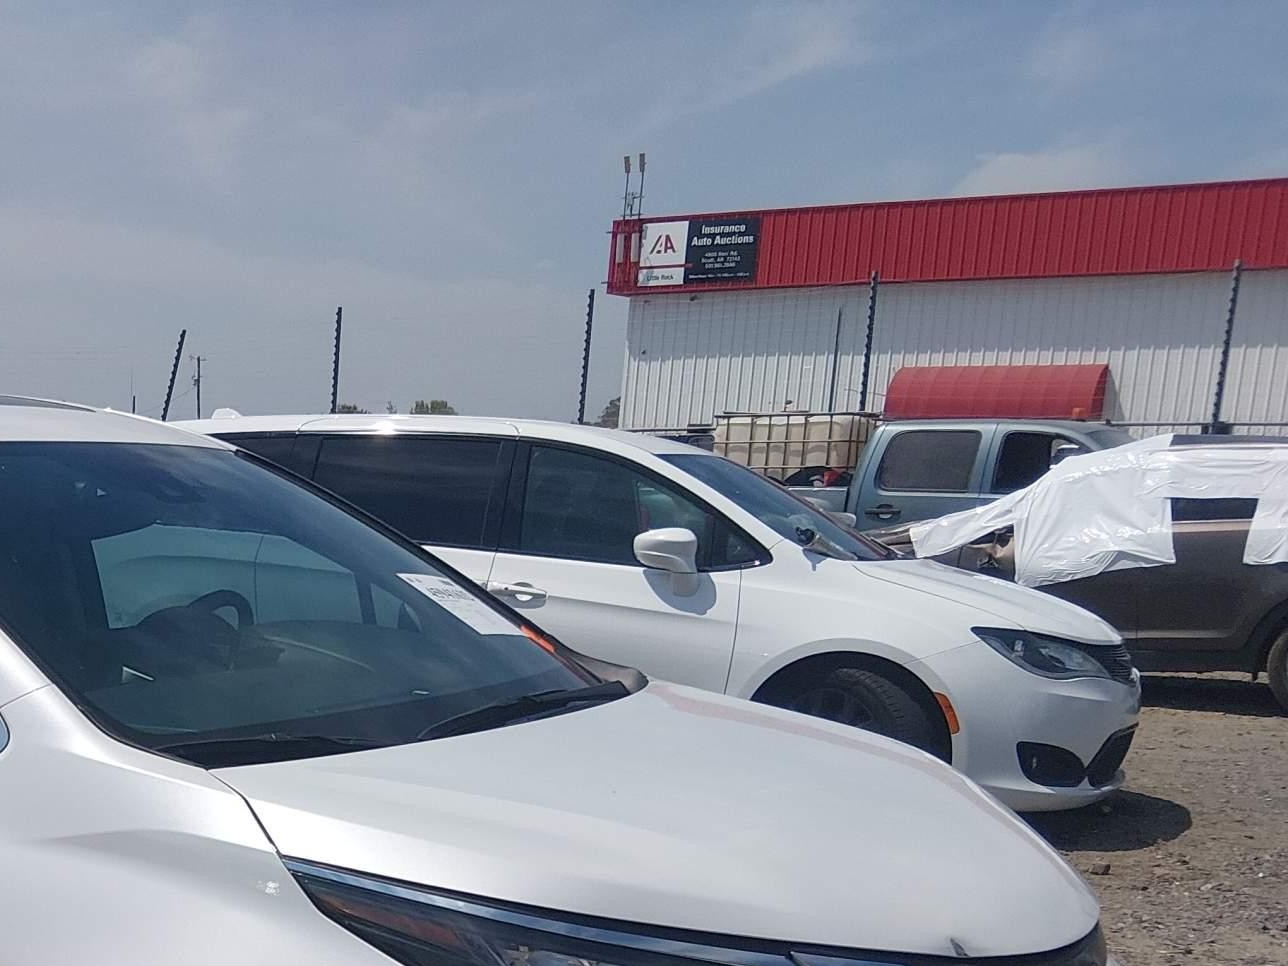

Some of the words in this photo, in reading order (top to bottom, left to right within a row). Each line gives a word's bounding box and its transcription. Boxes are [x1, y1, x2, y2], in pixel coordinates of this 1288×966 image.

[701, 224, 746, 235] Insurance
[691, 236, 712, 246] Auto
[713, 234, 754, 245] Auctions
